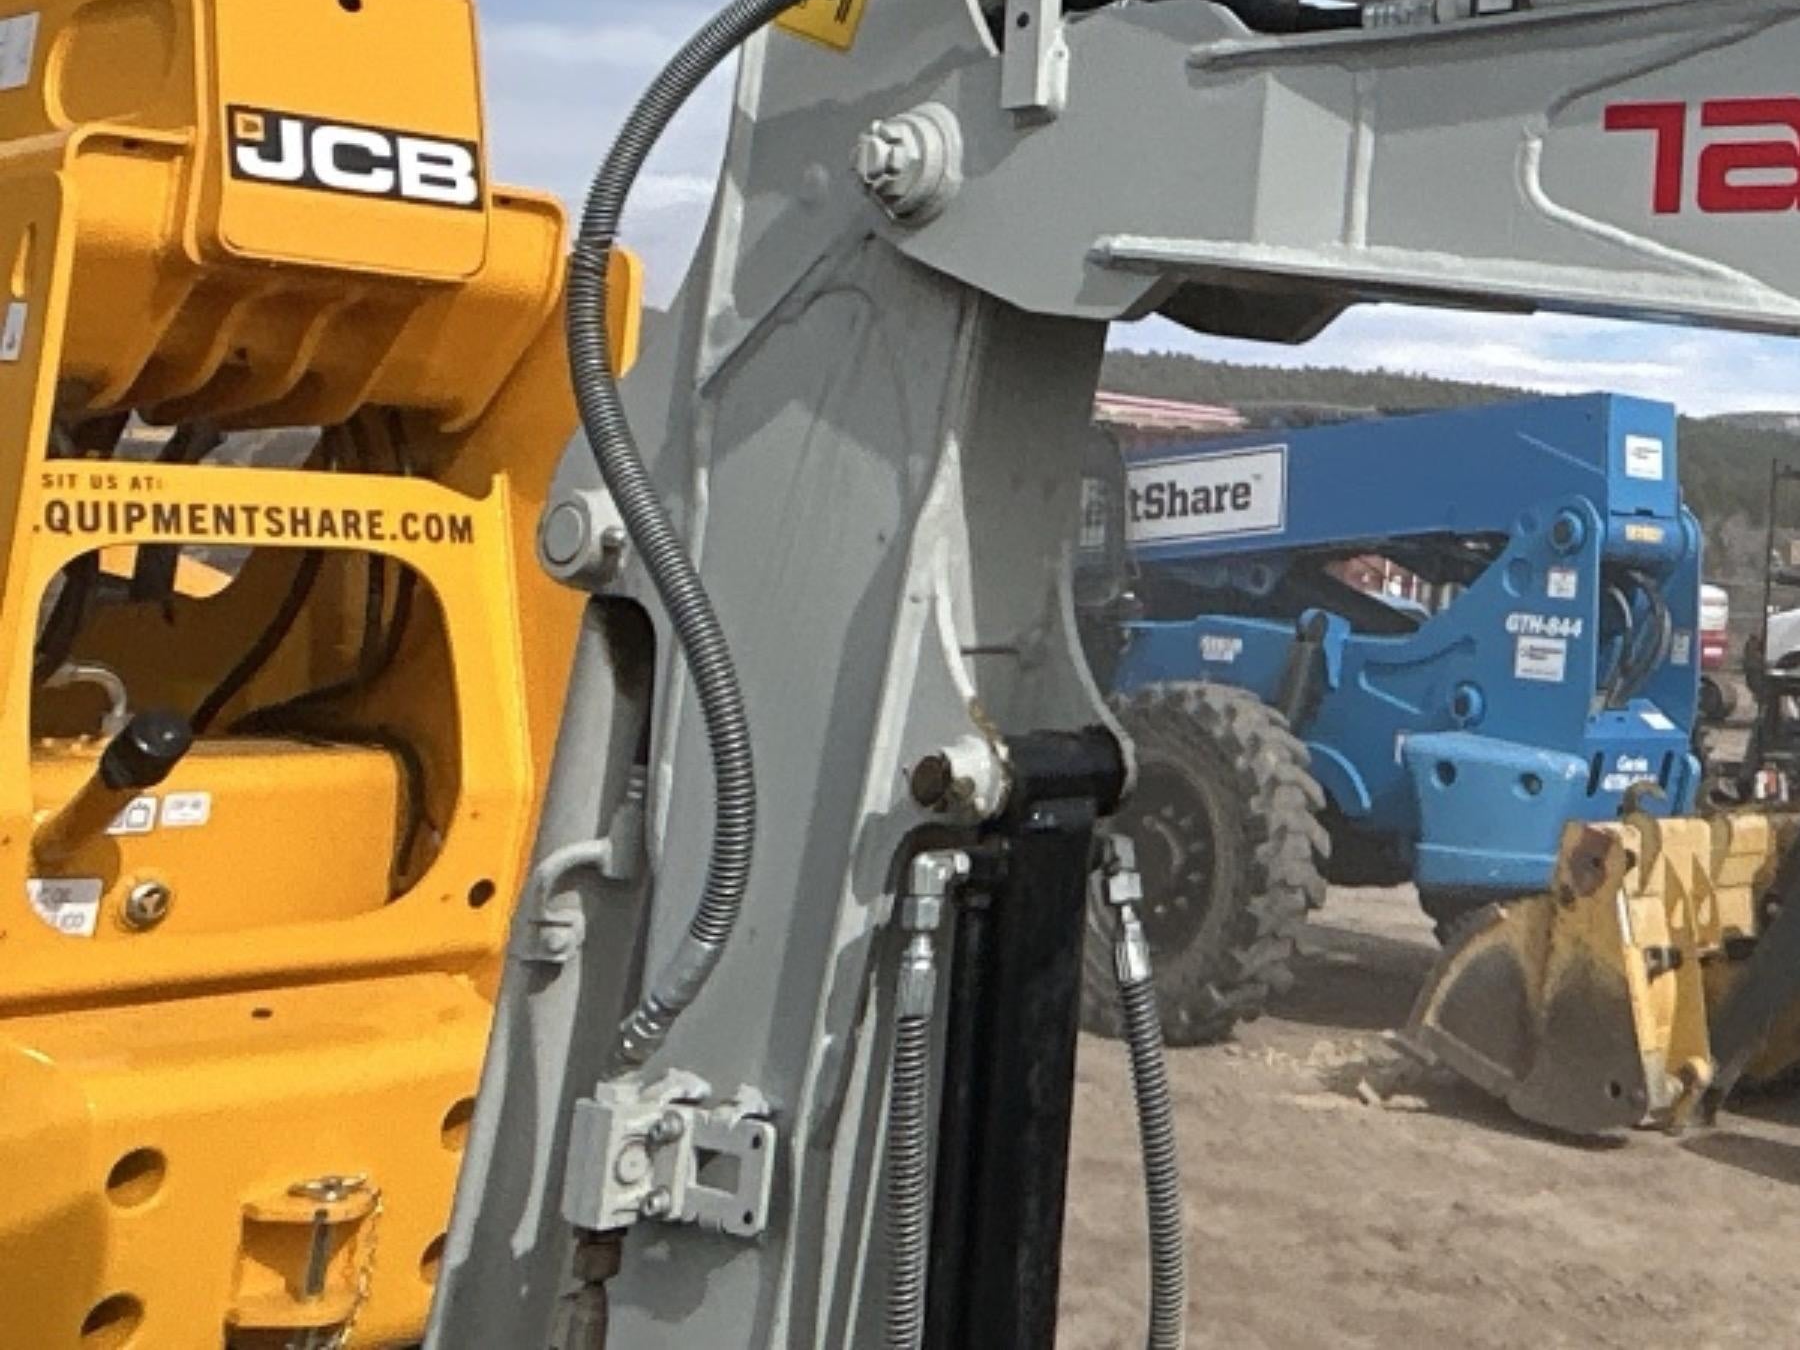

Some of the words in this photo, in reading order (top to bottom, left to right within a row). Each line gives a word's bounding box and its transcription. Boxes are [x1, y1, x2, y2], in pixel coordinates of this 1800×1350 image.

[236, 118, 478, 206] JCB
[90, 474, 118, 490] US
[33, 499, 475, 544] QUIPMENTSHARE.COM
